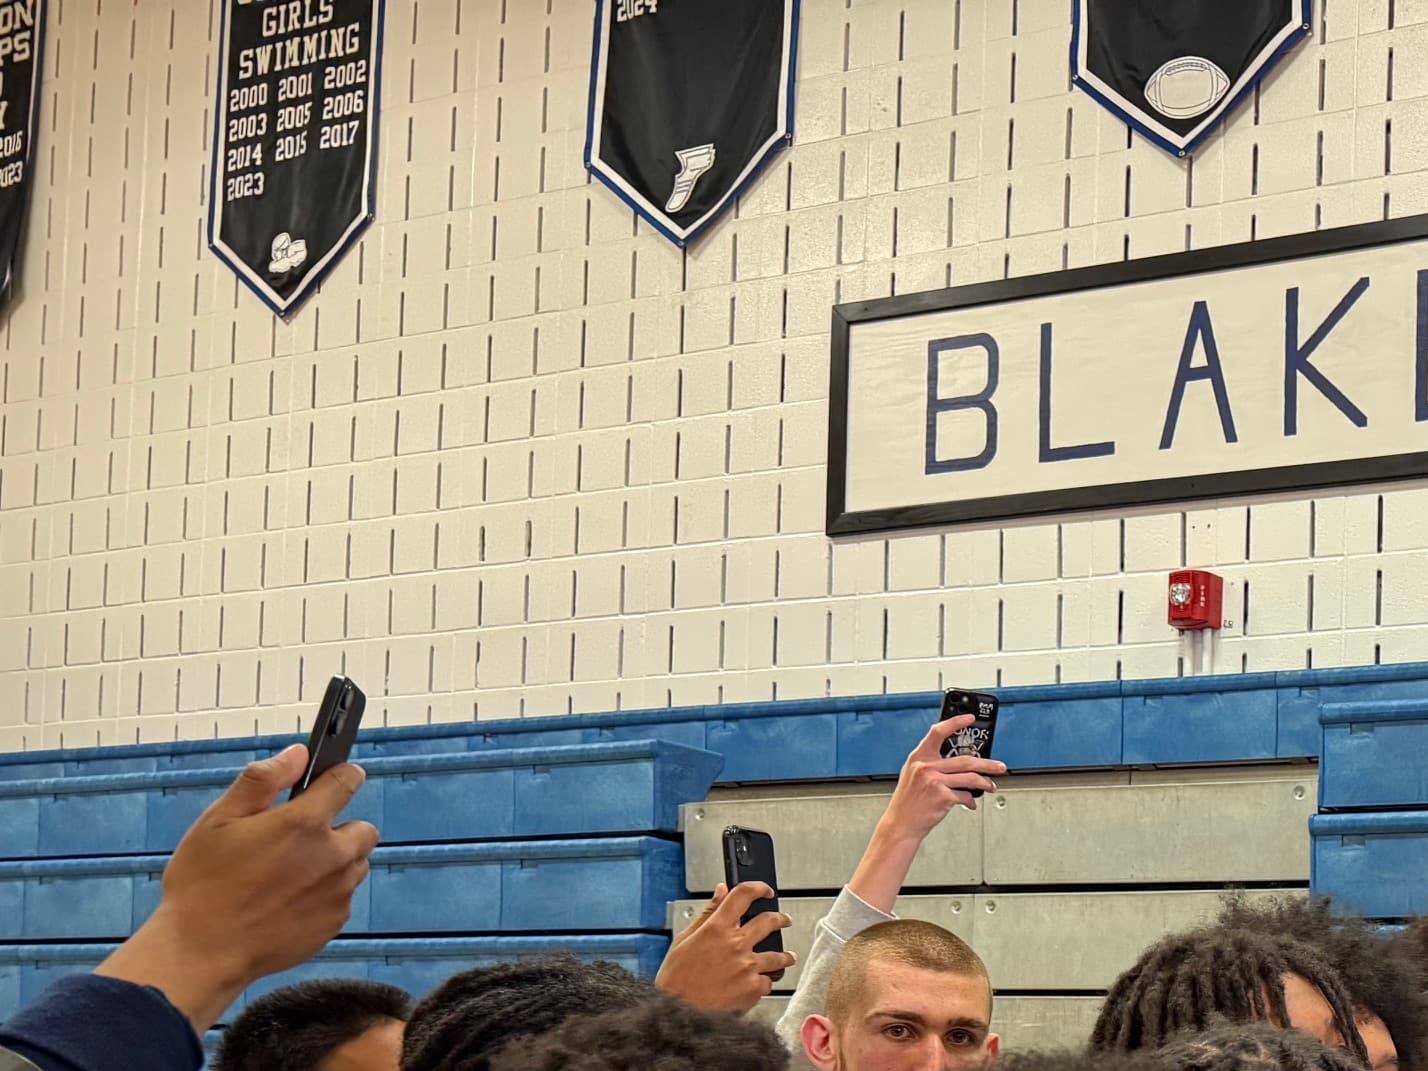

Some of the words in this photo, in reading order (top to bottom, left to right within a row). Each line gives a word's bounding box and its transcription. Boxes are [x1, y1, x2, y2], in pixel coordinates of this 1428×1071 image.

[262, 0, 334, 38] GIRLS
[238, 22, 361, 80] SWIMMING
[229, 82, 268, 112] 2000
[277, 72, 312, 102] 2001
[324, 59, 367, 90] 2002
[228, 112, 268, 143] 2003
[276, 101, 313, 132] 2005
[322, 90, 364, 120] 2006
[227, 142, 263, 172] 2014
[275, 130, 308, 162] 2015
[319, 119, 360, 149] 2017
[0, 160, 23, 188] 023
[227, 171, 265, 201] 2023
